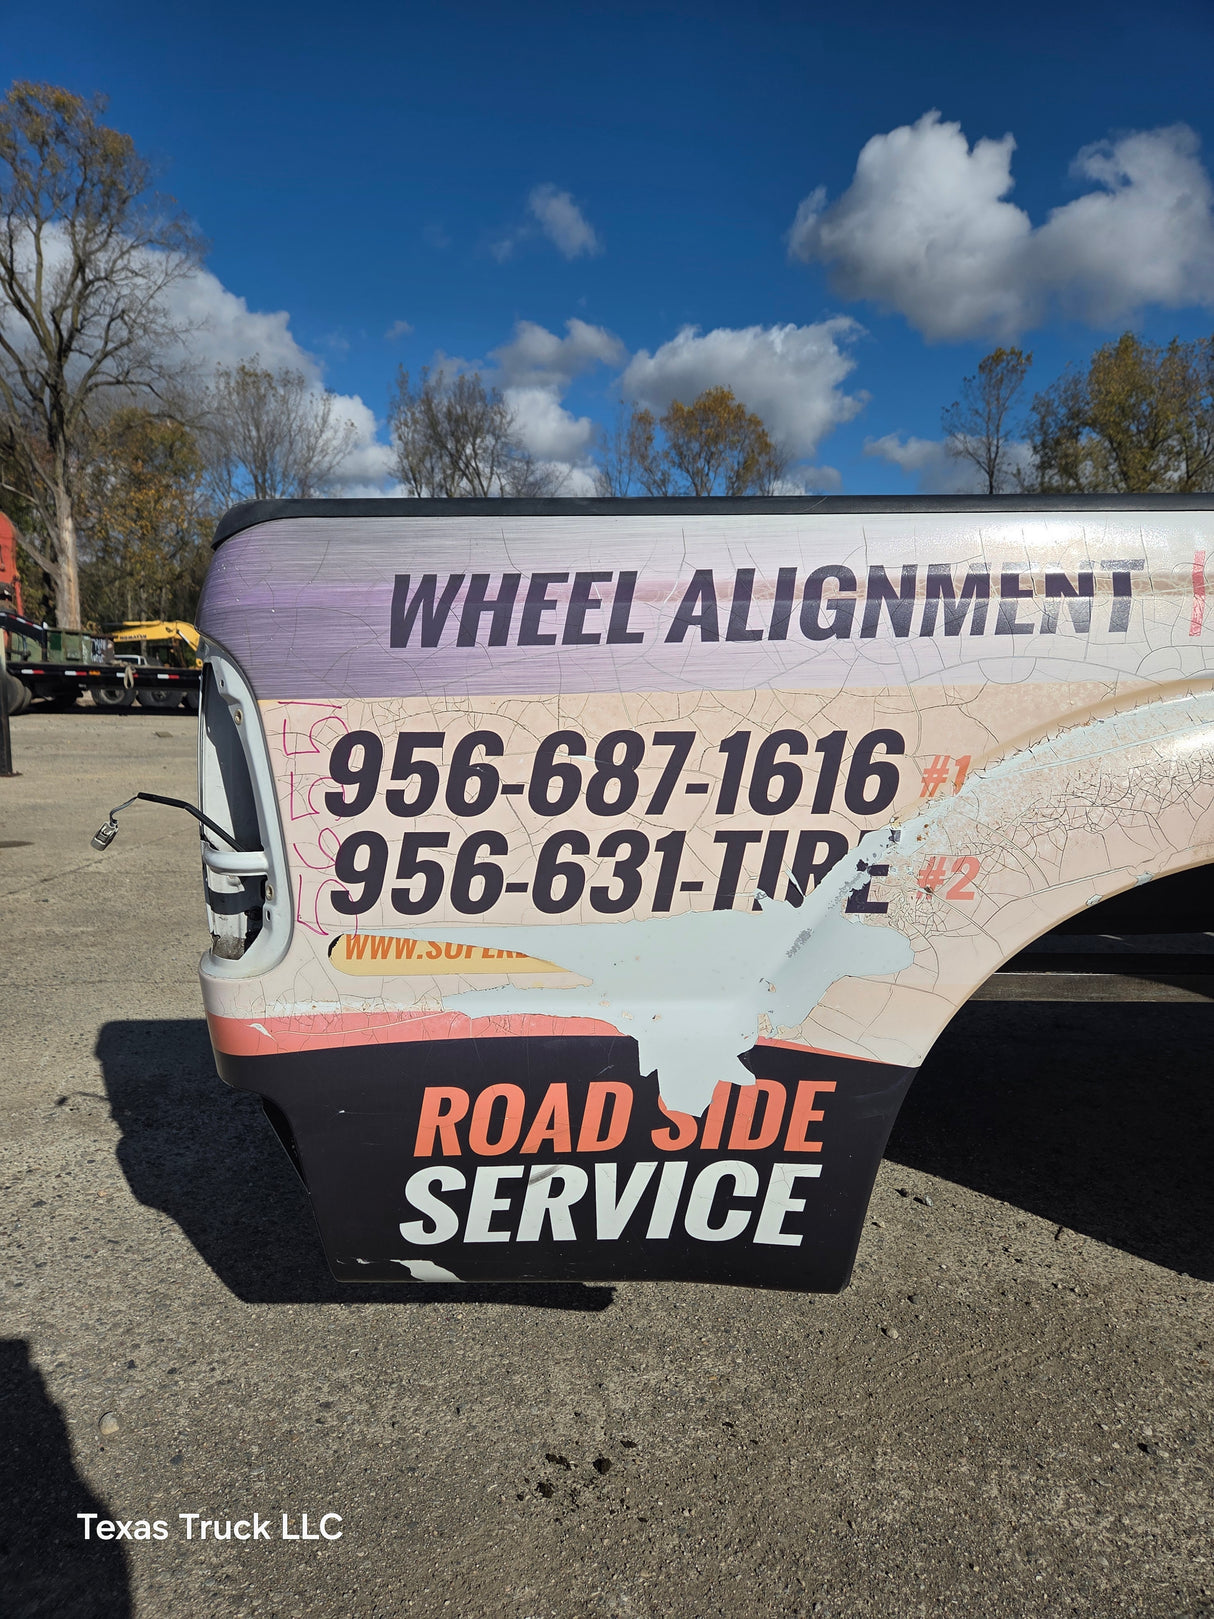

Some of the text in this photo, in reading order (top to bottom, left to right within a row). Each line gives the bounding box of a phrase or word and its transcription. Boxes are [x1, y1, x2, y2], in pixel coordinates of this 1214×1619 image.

[389, 570, 645, 649] WHEEL
[664, 558, 1146, 643] ALIGNMENT
[324, 728, 972, 818] 956-687-1616 #1
[915, 855, 982, 901] #2
[412, 1079, 838, 1157] ROAD SIDE
[399, 1159, 824, 1247] SERVICE
